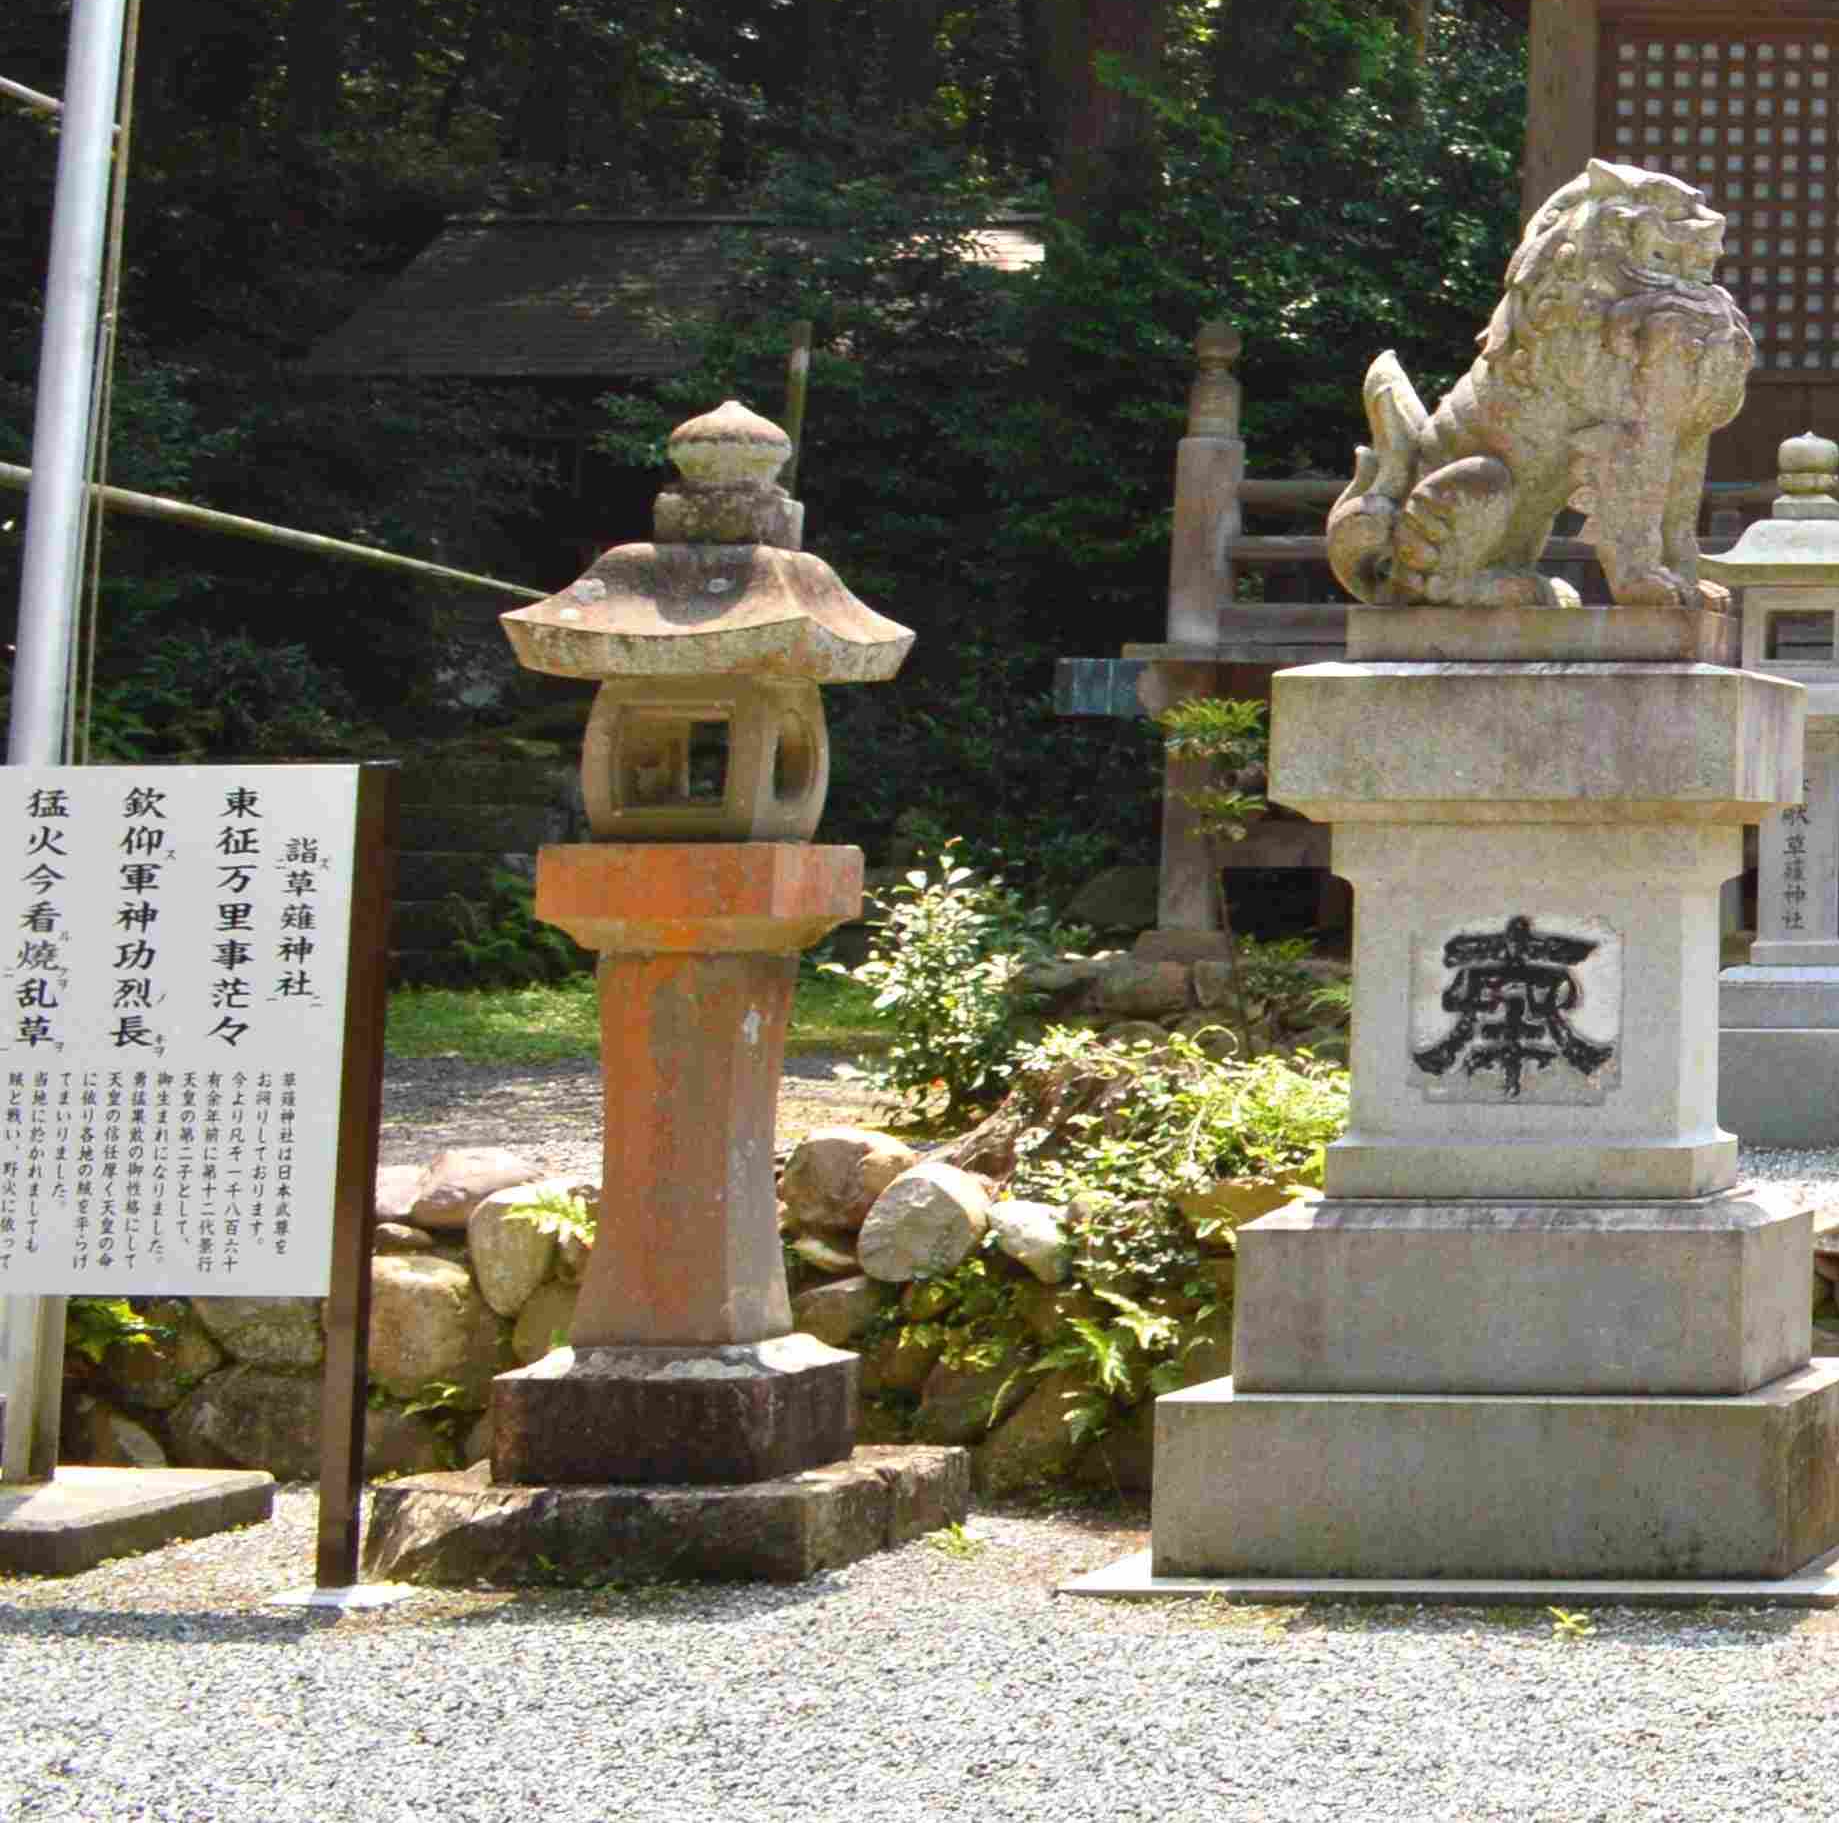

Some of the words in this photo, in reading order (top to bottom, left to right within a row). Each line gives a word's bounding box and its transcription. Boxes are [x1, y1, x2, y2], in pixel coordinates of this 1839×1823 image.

[110, 786, 167, 1047] 欽仰軍神功烈長
[207, 786, 263, 1047] 東征万里事茫々
[274, 837, 320, 997] 詣草薙神社
